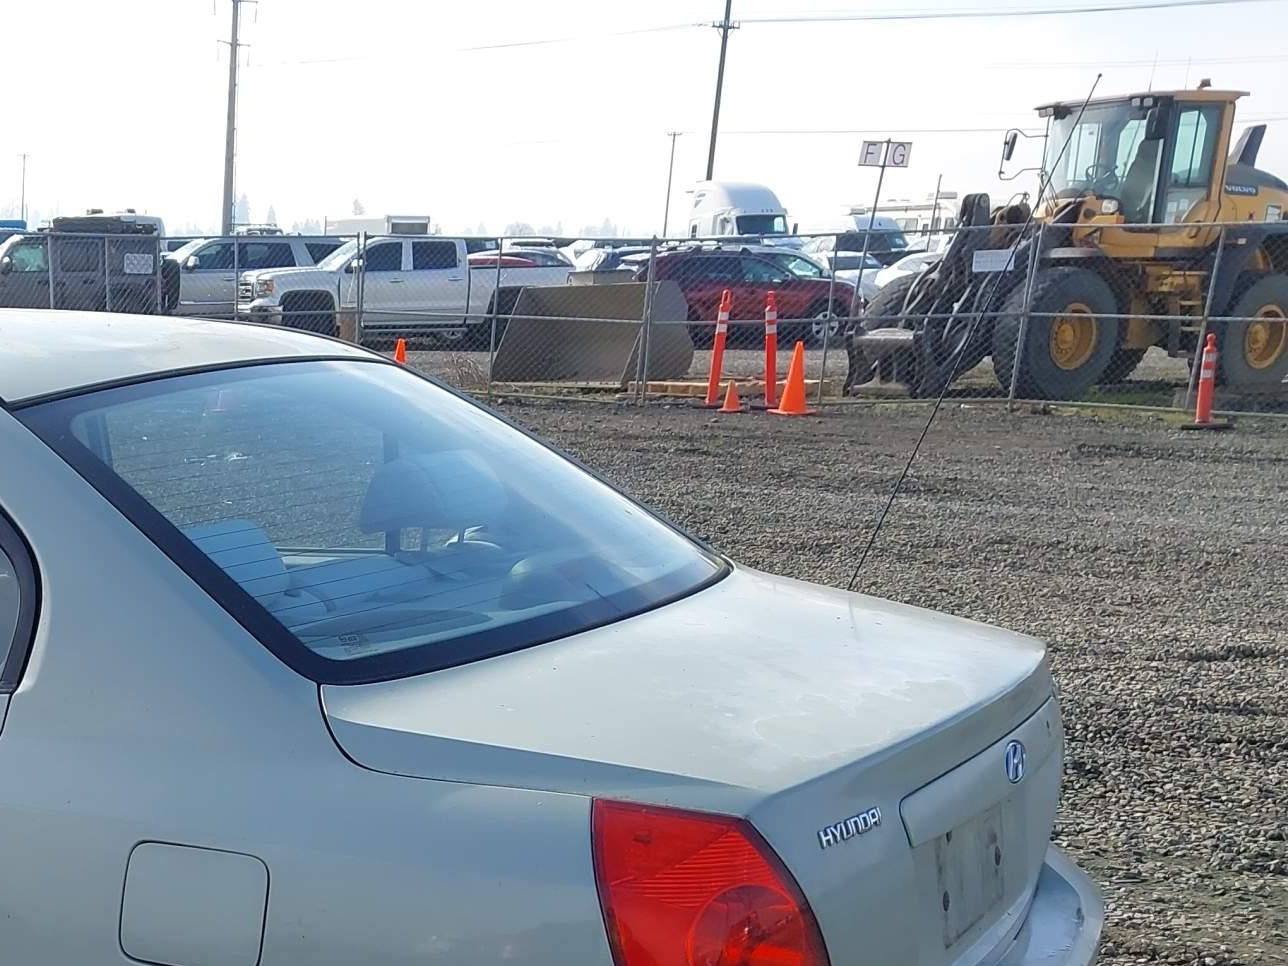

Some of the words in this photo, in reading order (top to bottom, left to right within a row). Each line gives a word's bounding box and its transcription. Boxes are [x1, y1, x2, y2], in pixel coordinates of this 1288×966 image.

[863, 143, 877, 164] F
[892, 143, 906, 165] G
[818, 807, 881, 848] HYUNDAI
